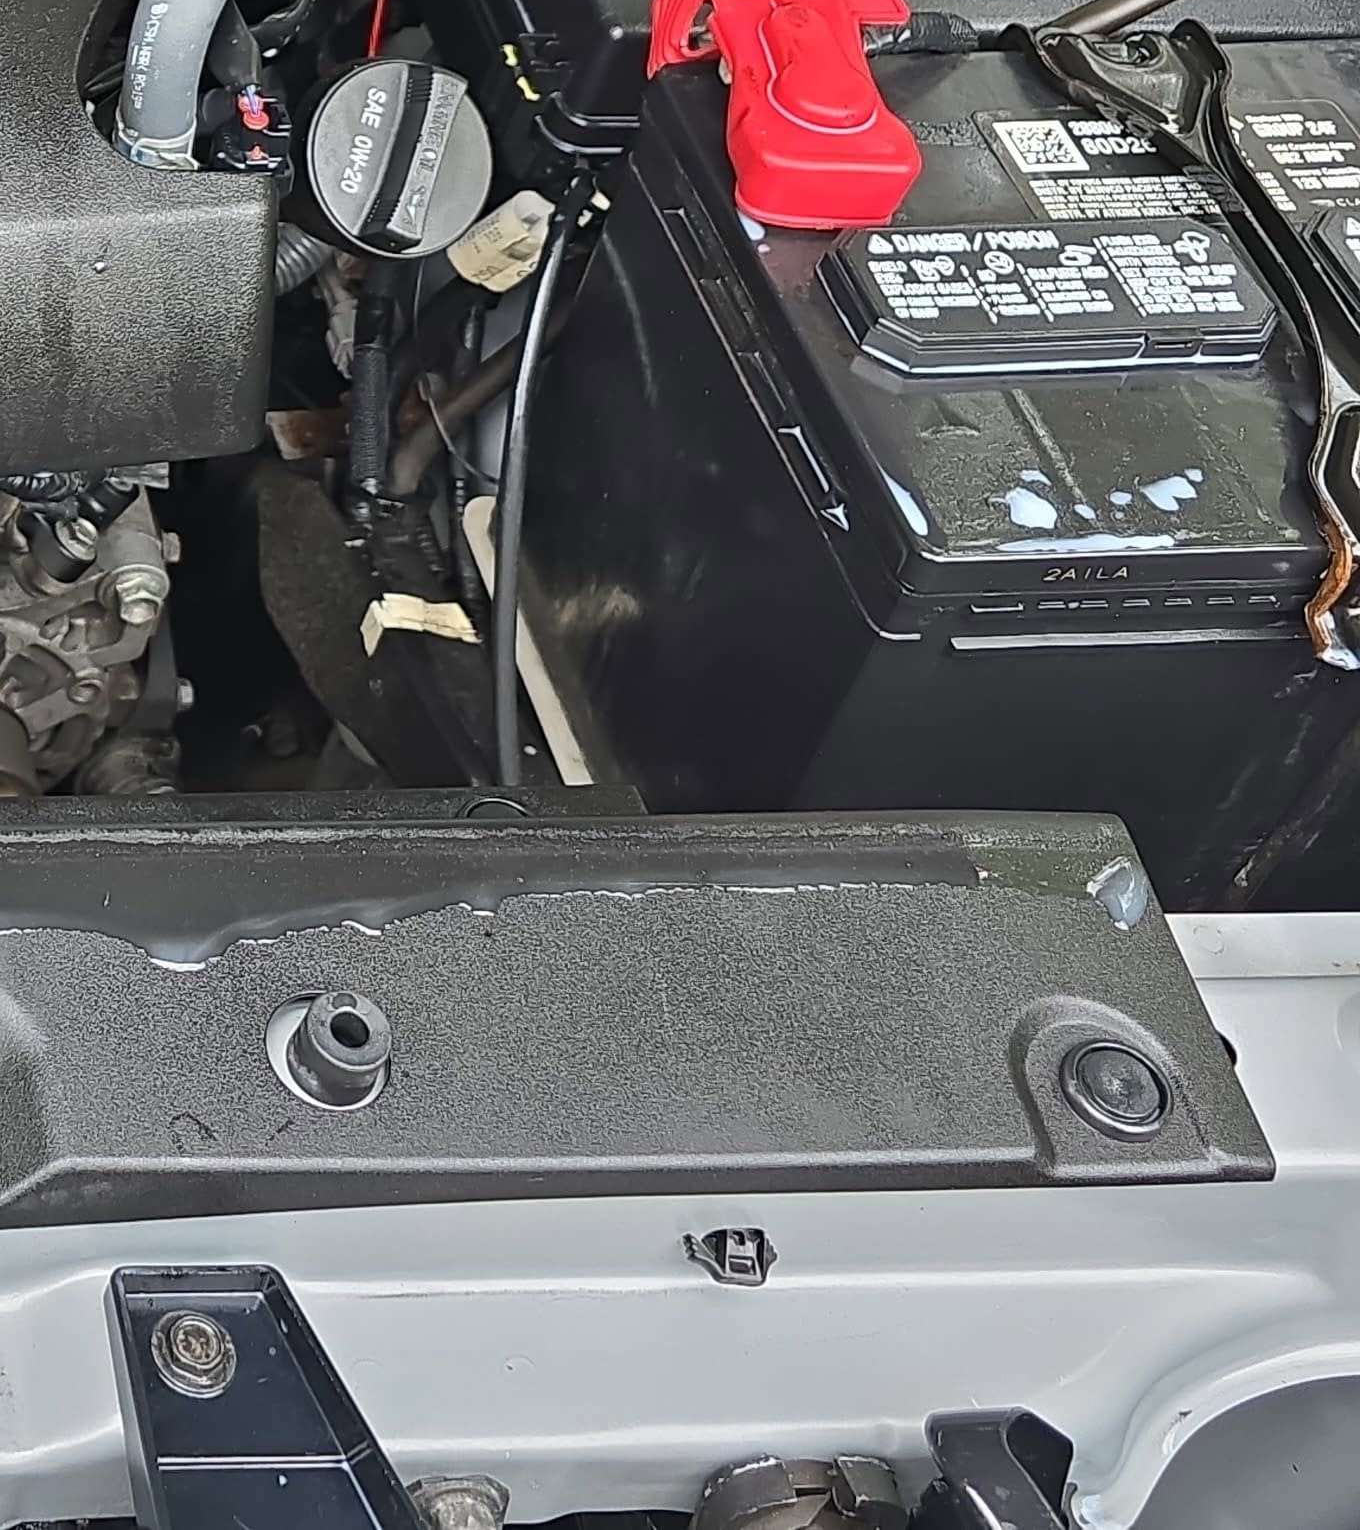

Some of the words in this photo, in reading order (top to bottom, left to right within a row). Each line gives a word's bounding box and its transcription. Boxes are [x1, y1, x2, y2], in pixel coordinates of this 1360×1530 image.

[360, 87, 387, 129] SAE
[340, 134, 373, 194] 0W-20
[891, 233, 972, 253] DANGER
[983, 230, 1060, 250] POISON
